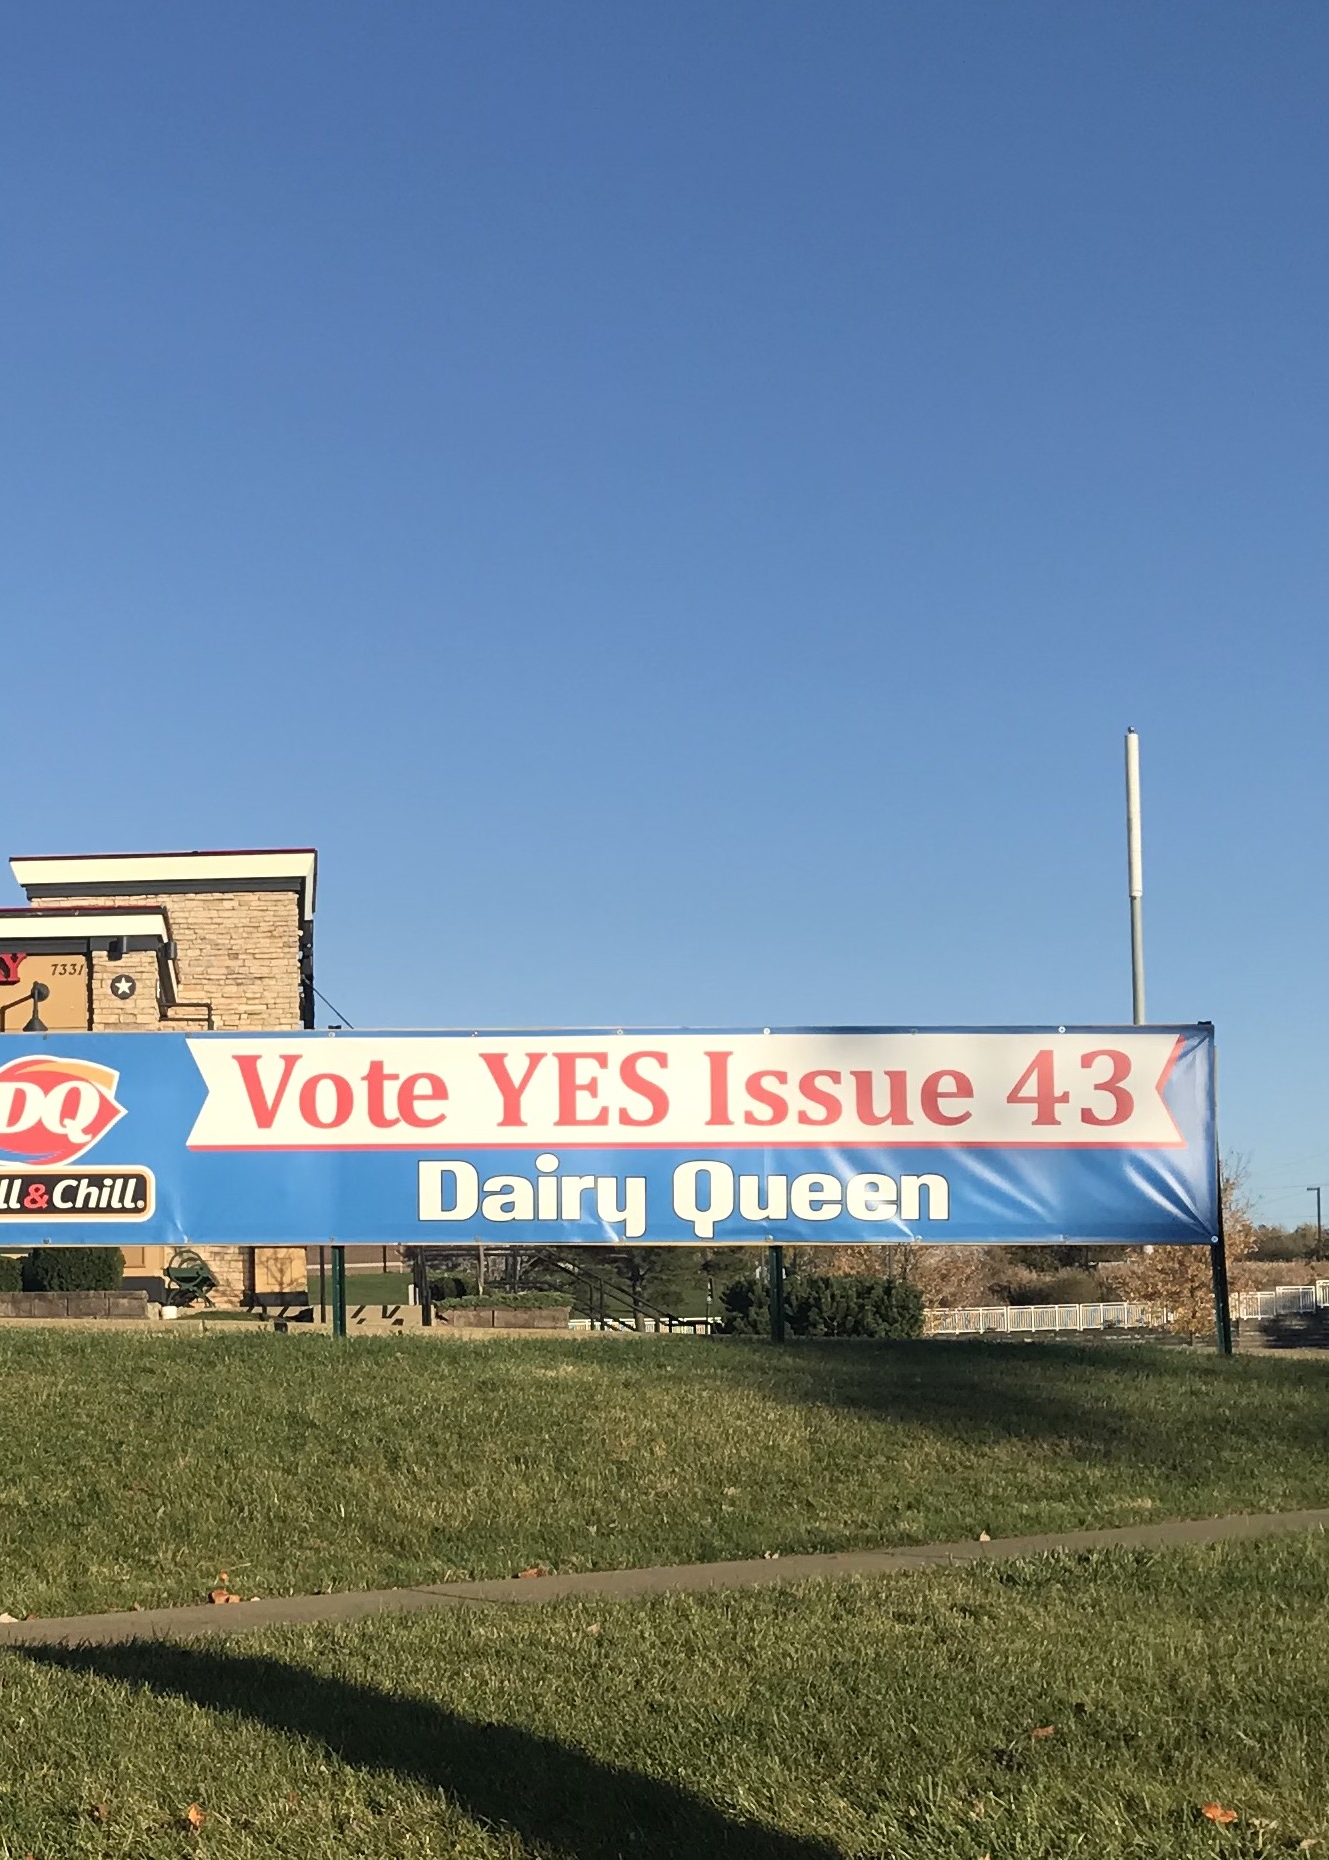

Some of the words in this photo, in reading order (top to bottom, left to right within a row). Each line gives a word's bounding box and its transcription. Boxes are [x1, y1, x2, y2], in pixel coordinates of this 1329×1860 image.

[50, 963, 85, 976] 7331
[231, 1053, 449, 1129] Vote
[478, 1050, 670, 1127] YES
[703, 1050, 975, 1127] Issue
[1006, 1049, 1135, 1127] 43
[418, 1152, 647, 1238] Dairy
[672, 1159, 950, 1239] Queen
